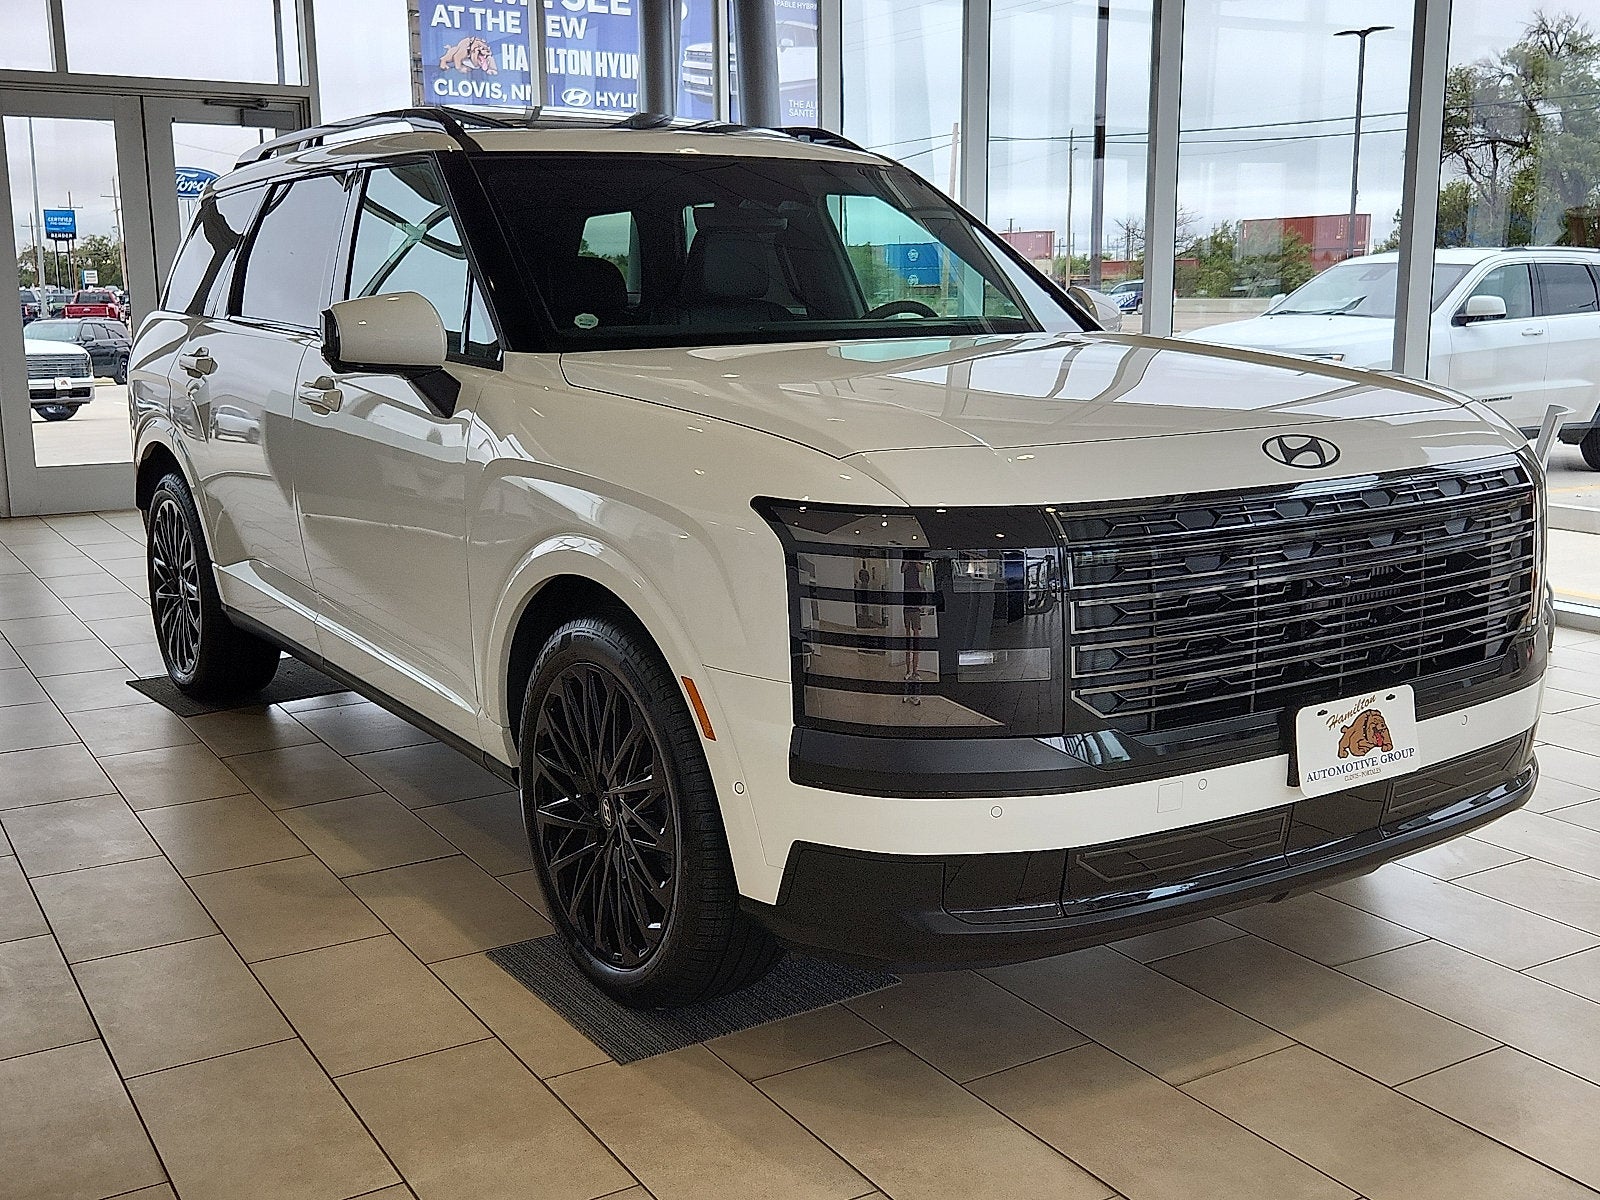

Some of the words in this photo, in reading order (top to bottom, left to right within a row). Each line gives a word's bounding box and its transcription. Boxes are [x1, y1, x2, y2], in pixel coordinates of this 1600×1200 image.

[430, 4, 465, 29] AT
[469, 7, 522, 34] THE
[546, 15, 588, 40] EW
[501, 43, 592, 77] HALTON
[433, 78, 507, 103] CLOVIS,
[788, 99, 804, 109] THE
[175, 171, 211, 192] Ford
[1325, 694, 1377, 732] Hamilton
[1306, 756, 1379, 783] AUTOMOTIVE
[1380, 747, 1415, 765] GROUP
